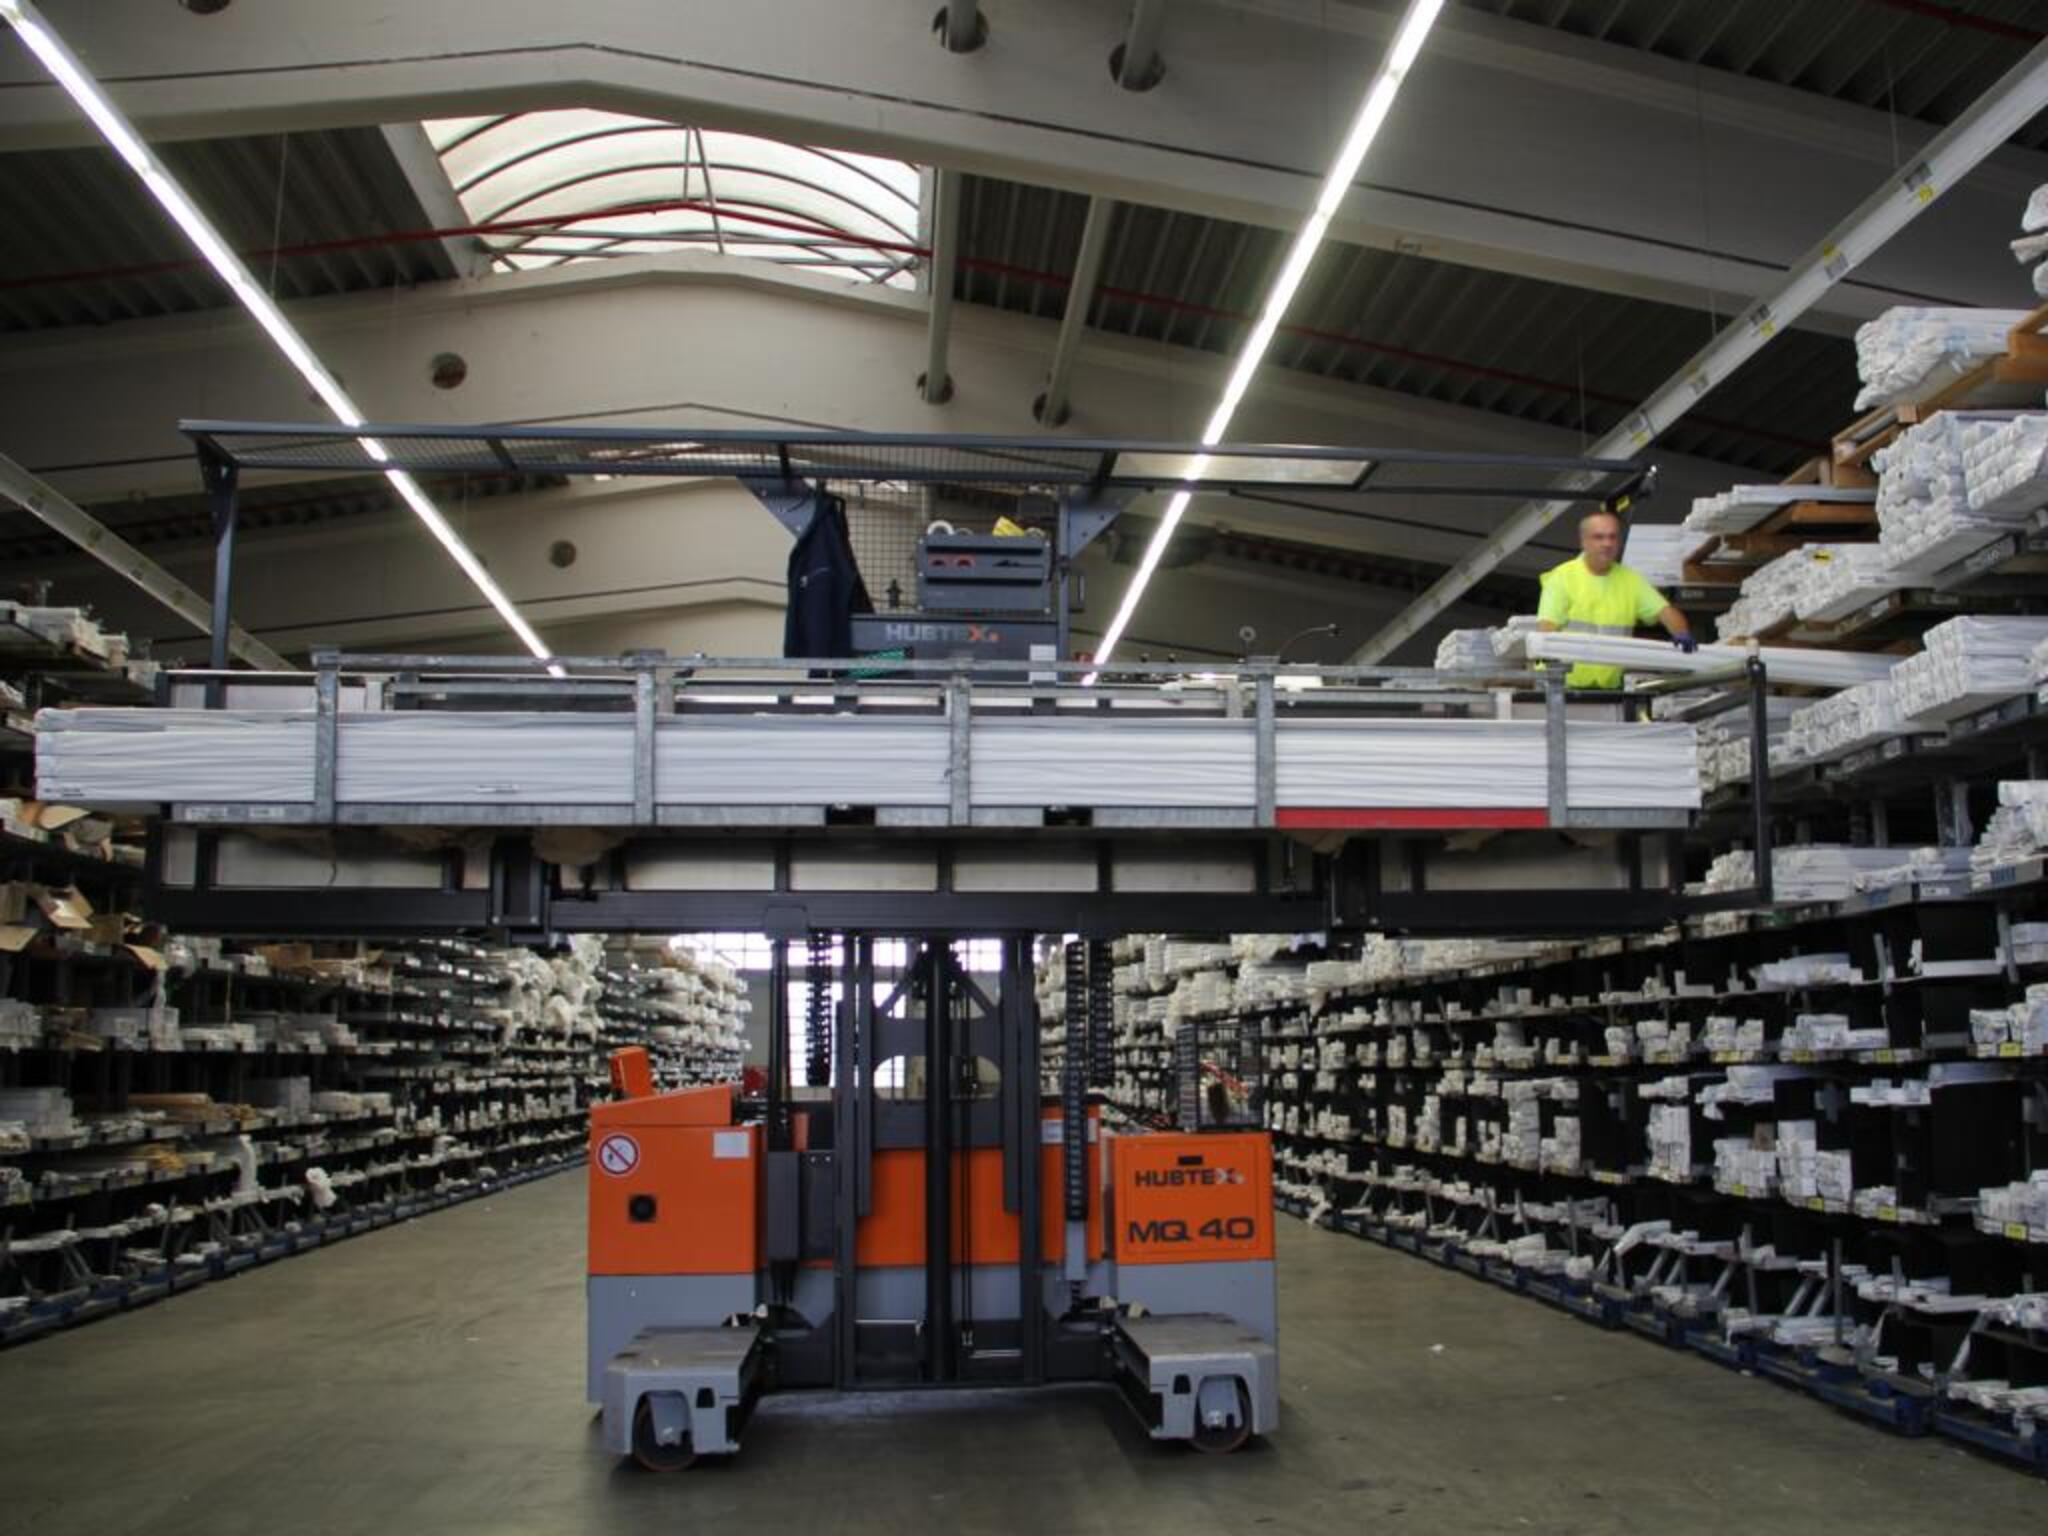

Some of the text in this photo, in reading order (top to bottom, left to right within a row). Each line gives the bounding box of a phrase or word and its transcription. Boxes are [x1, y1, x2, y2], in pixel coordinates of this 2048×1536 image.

[1135, 1168, 1236, 1187] HUBTEX
[1128, 1217, 1256, 1243] MQ 40
